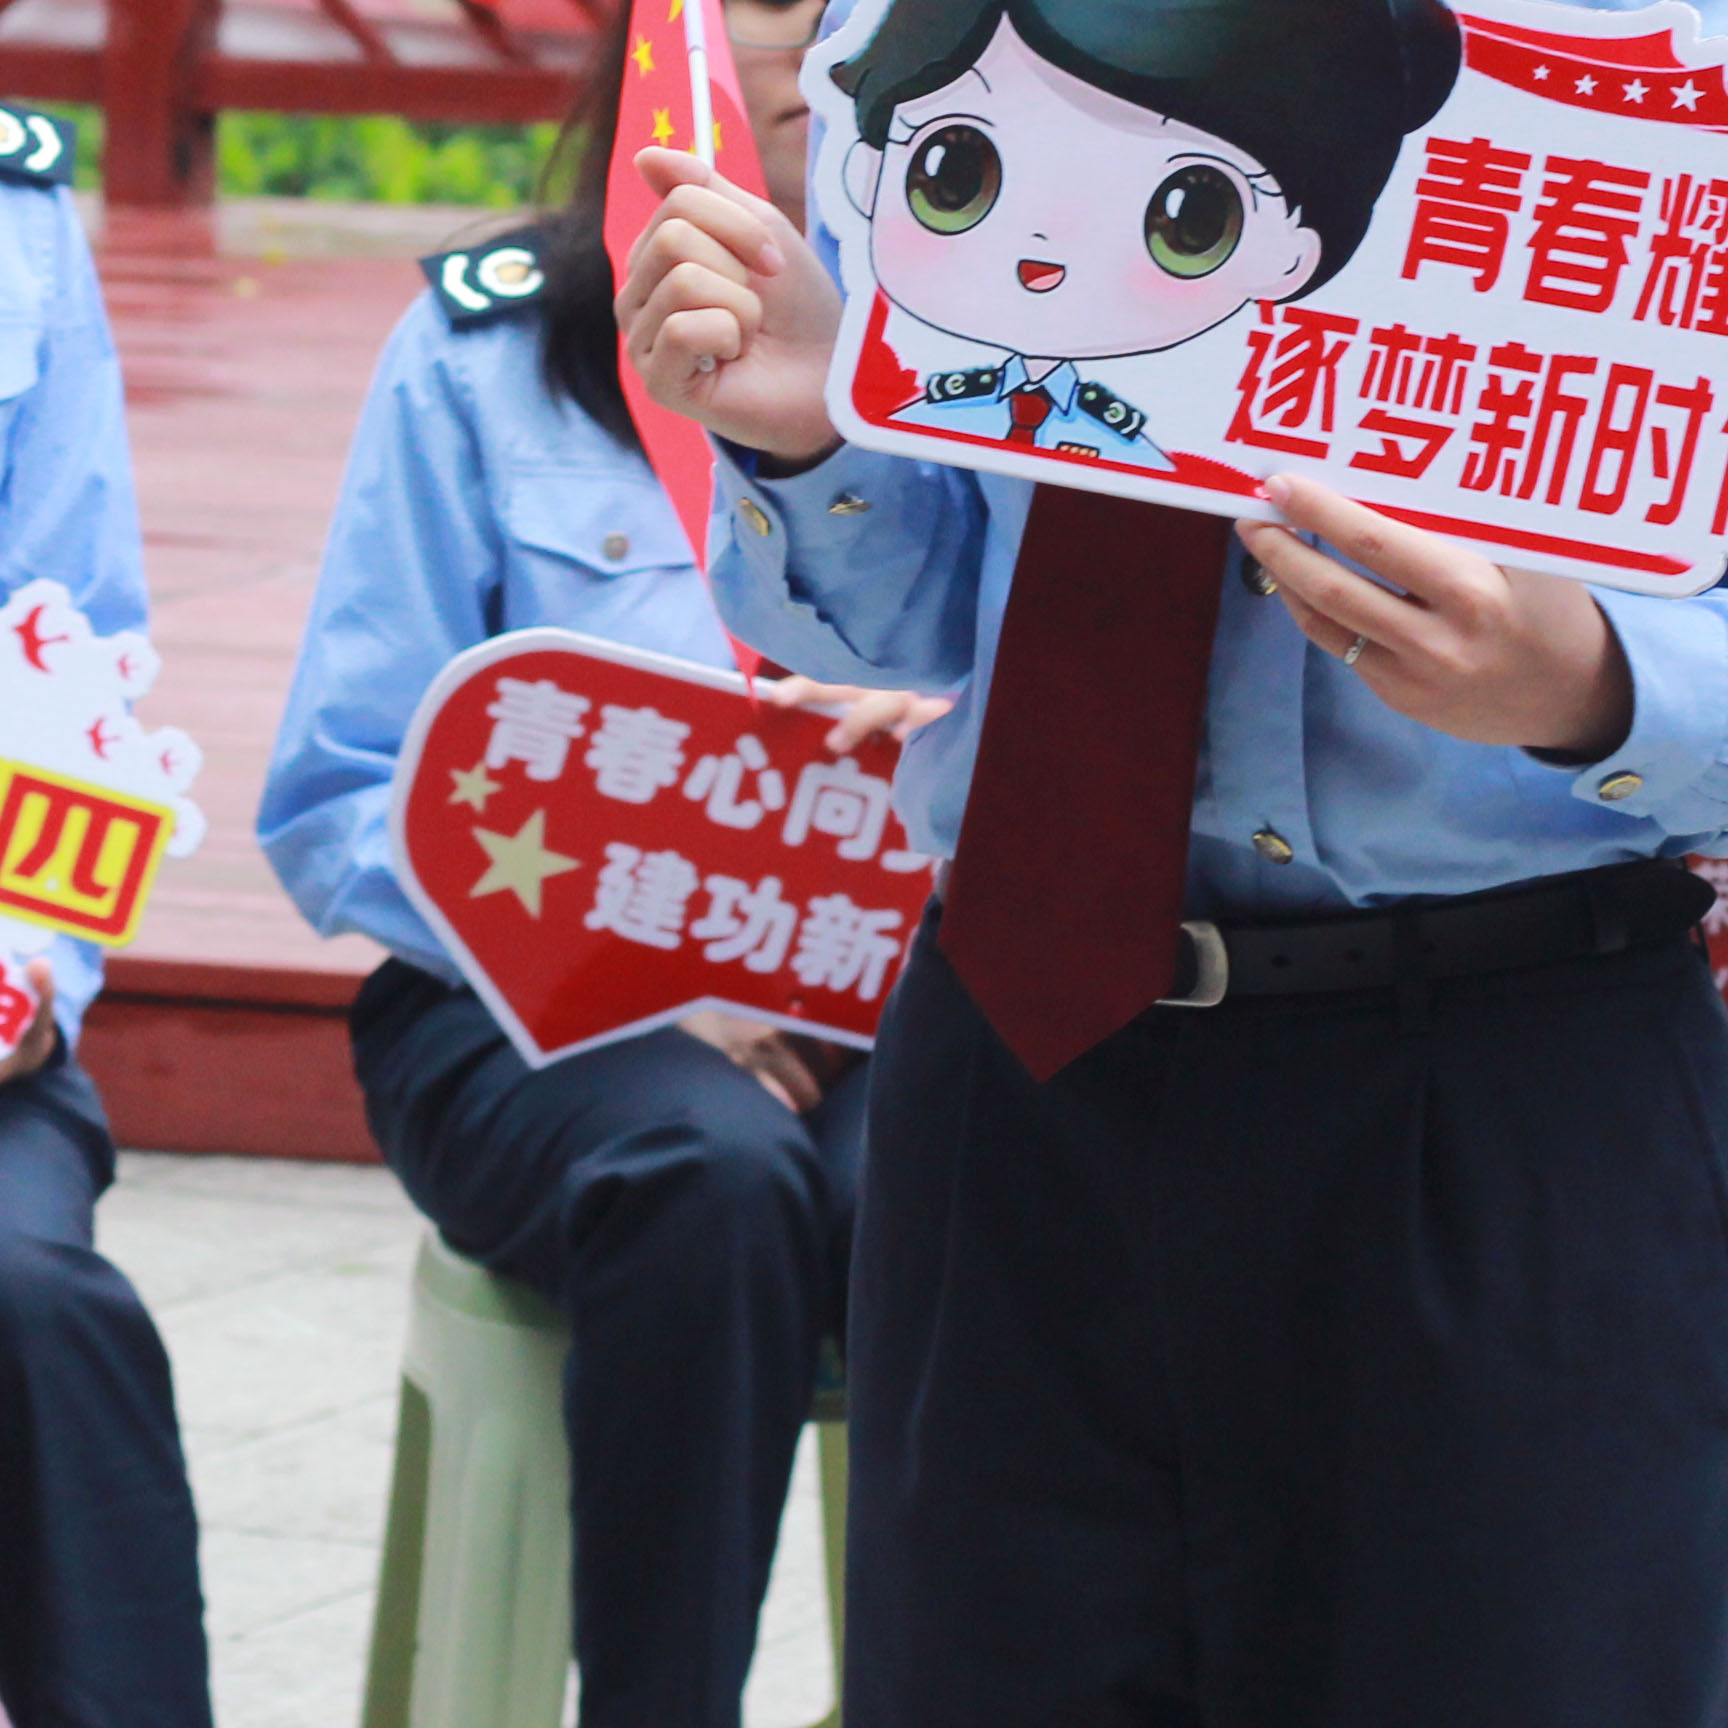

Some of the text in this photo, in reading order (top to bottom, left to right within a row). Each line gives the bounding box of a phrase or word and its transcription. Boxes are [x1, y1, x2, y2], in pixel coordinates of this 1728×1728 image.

[486, 677, 936, 874] 青春心向
[583, 842, 903, 1002] 建功新
